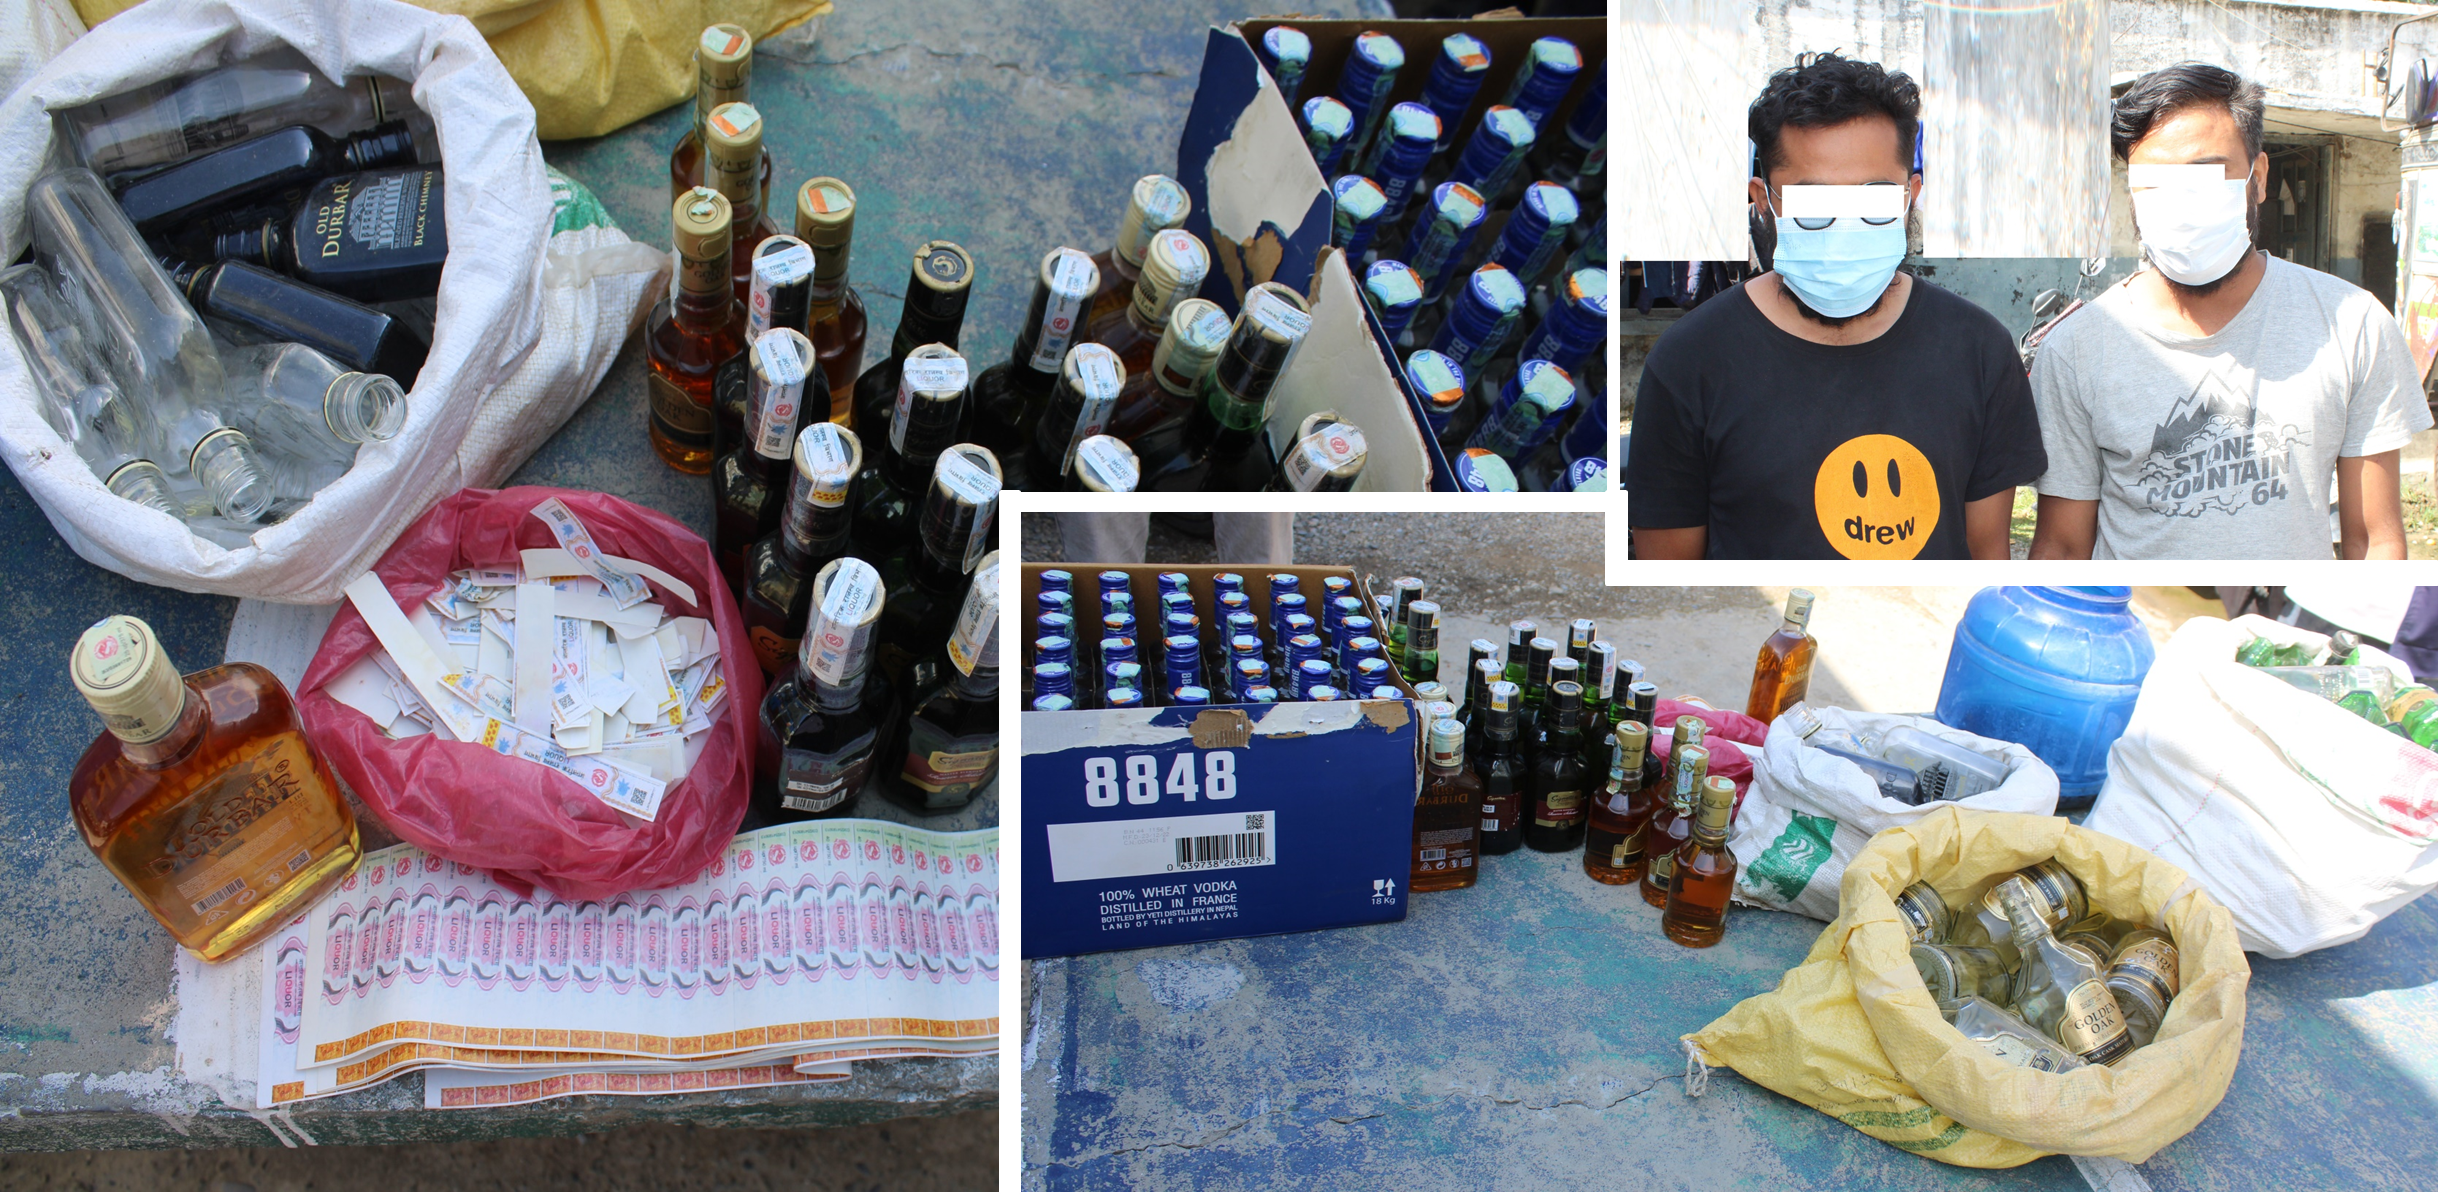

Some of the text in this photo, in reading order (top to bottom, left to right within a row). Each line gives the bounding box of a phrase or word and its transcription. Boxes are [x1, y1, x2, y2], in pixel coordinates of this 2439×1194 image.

[316, 206, 330, 234] OLD
[322, 180, 352, 258] DURBAR
[414, 171, 432, 246] BLACK CHIMNEY
[2173, 433, 2255, 478] STONE
[2146, 450, 2290, 504] MOUNTAIN
[2251, 478, 2288, 505] 64
[1844, 515, 1914, 545] drew
[846, 587, 862, 616] LIQUOR
[544, 751, 570, 764] LIQUOR
[1084, 750, 1237, 807] 8848
[141, 773, 300, 880] DURBAR
[188, 796, 243, 835] OLD
[1167, 858, 1261, 871] 0 639738 262925
[1099, 880, 1238, 902] 100% WHEAT VODKA
[1100, 893, 1238, 915] DISTILLED IN FRANCE
[1384, 897, 1396, 905] Kg
[415, 915, 425, 949] LIQUOR
[771, 912, 779, 949] LIQUOR
[804, 908, 812, 945] LIQUOR
[837, 906, 846, 943] LIQUOR
[869, 906, 878, 943] LIQUOR
[898, 908, 907, 945] LIQUOR
[922, 914, 931, 949] LIQUOR
[976, 915, 988, 948] LIQUOR
[1101, 914, 1135, 923] BOTTLED
[1164, 908, 1206, 917] DISTILLERY
[1102, 922, 1130, 931] LAND
[1178, 911, 1239, 923] HIMALAYAS
[362, 929, 370, 964] LIQUOR
[386, 920, 394, 954] LIQUOR
[449, 918, 458, 952] LIQUOR
[482, 922, 491, 956] LIQUOR
[516, 923, 525, 957] LIQUOR
[550, 923, 558, 957] LIQUOR
[583, 923, 591, 957] LIQUOR
[616, 924, 624, 959] LIQUOR
[947, 916, 958, 951] LIQUOR
[333, 936, 342, 971] LIQUOR
[2135, 947, 2178, 979] GOLDEN
[2074, 1001, 2116, 1030] GOLDEN
[2091, 1014, 2115, 1034] OAK
[2088, 1046, 2116, 1061] OAK CASK
